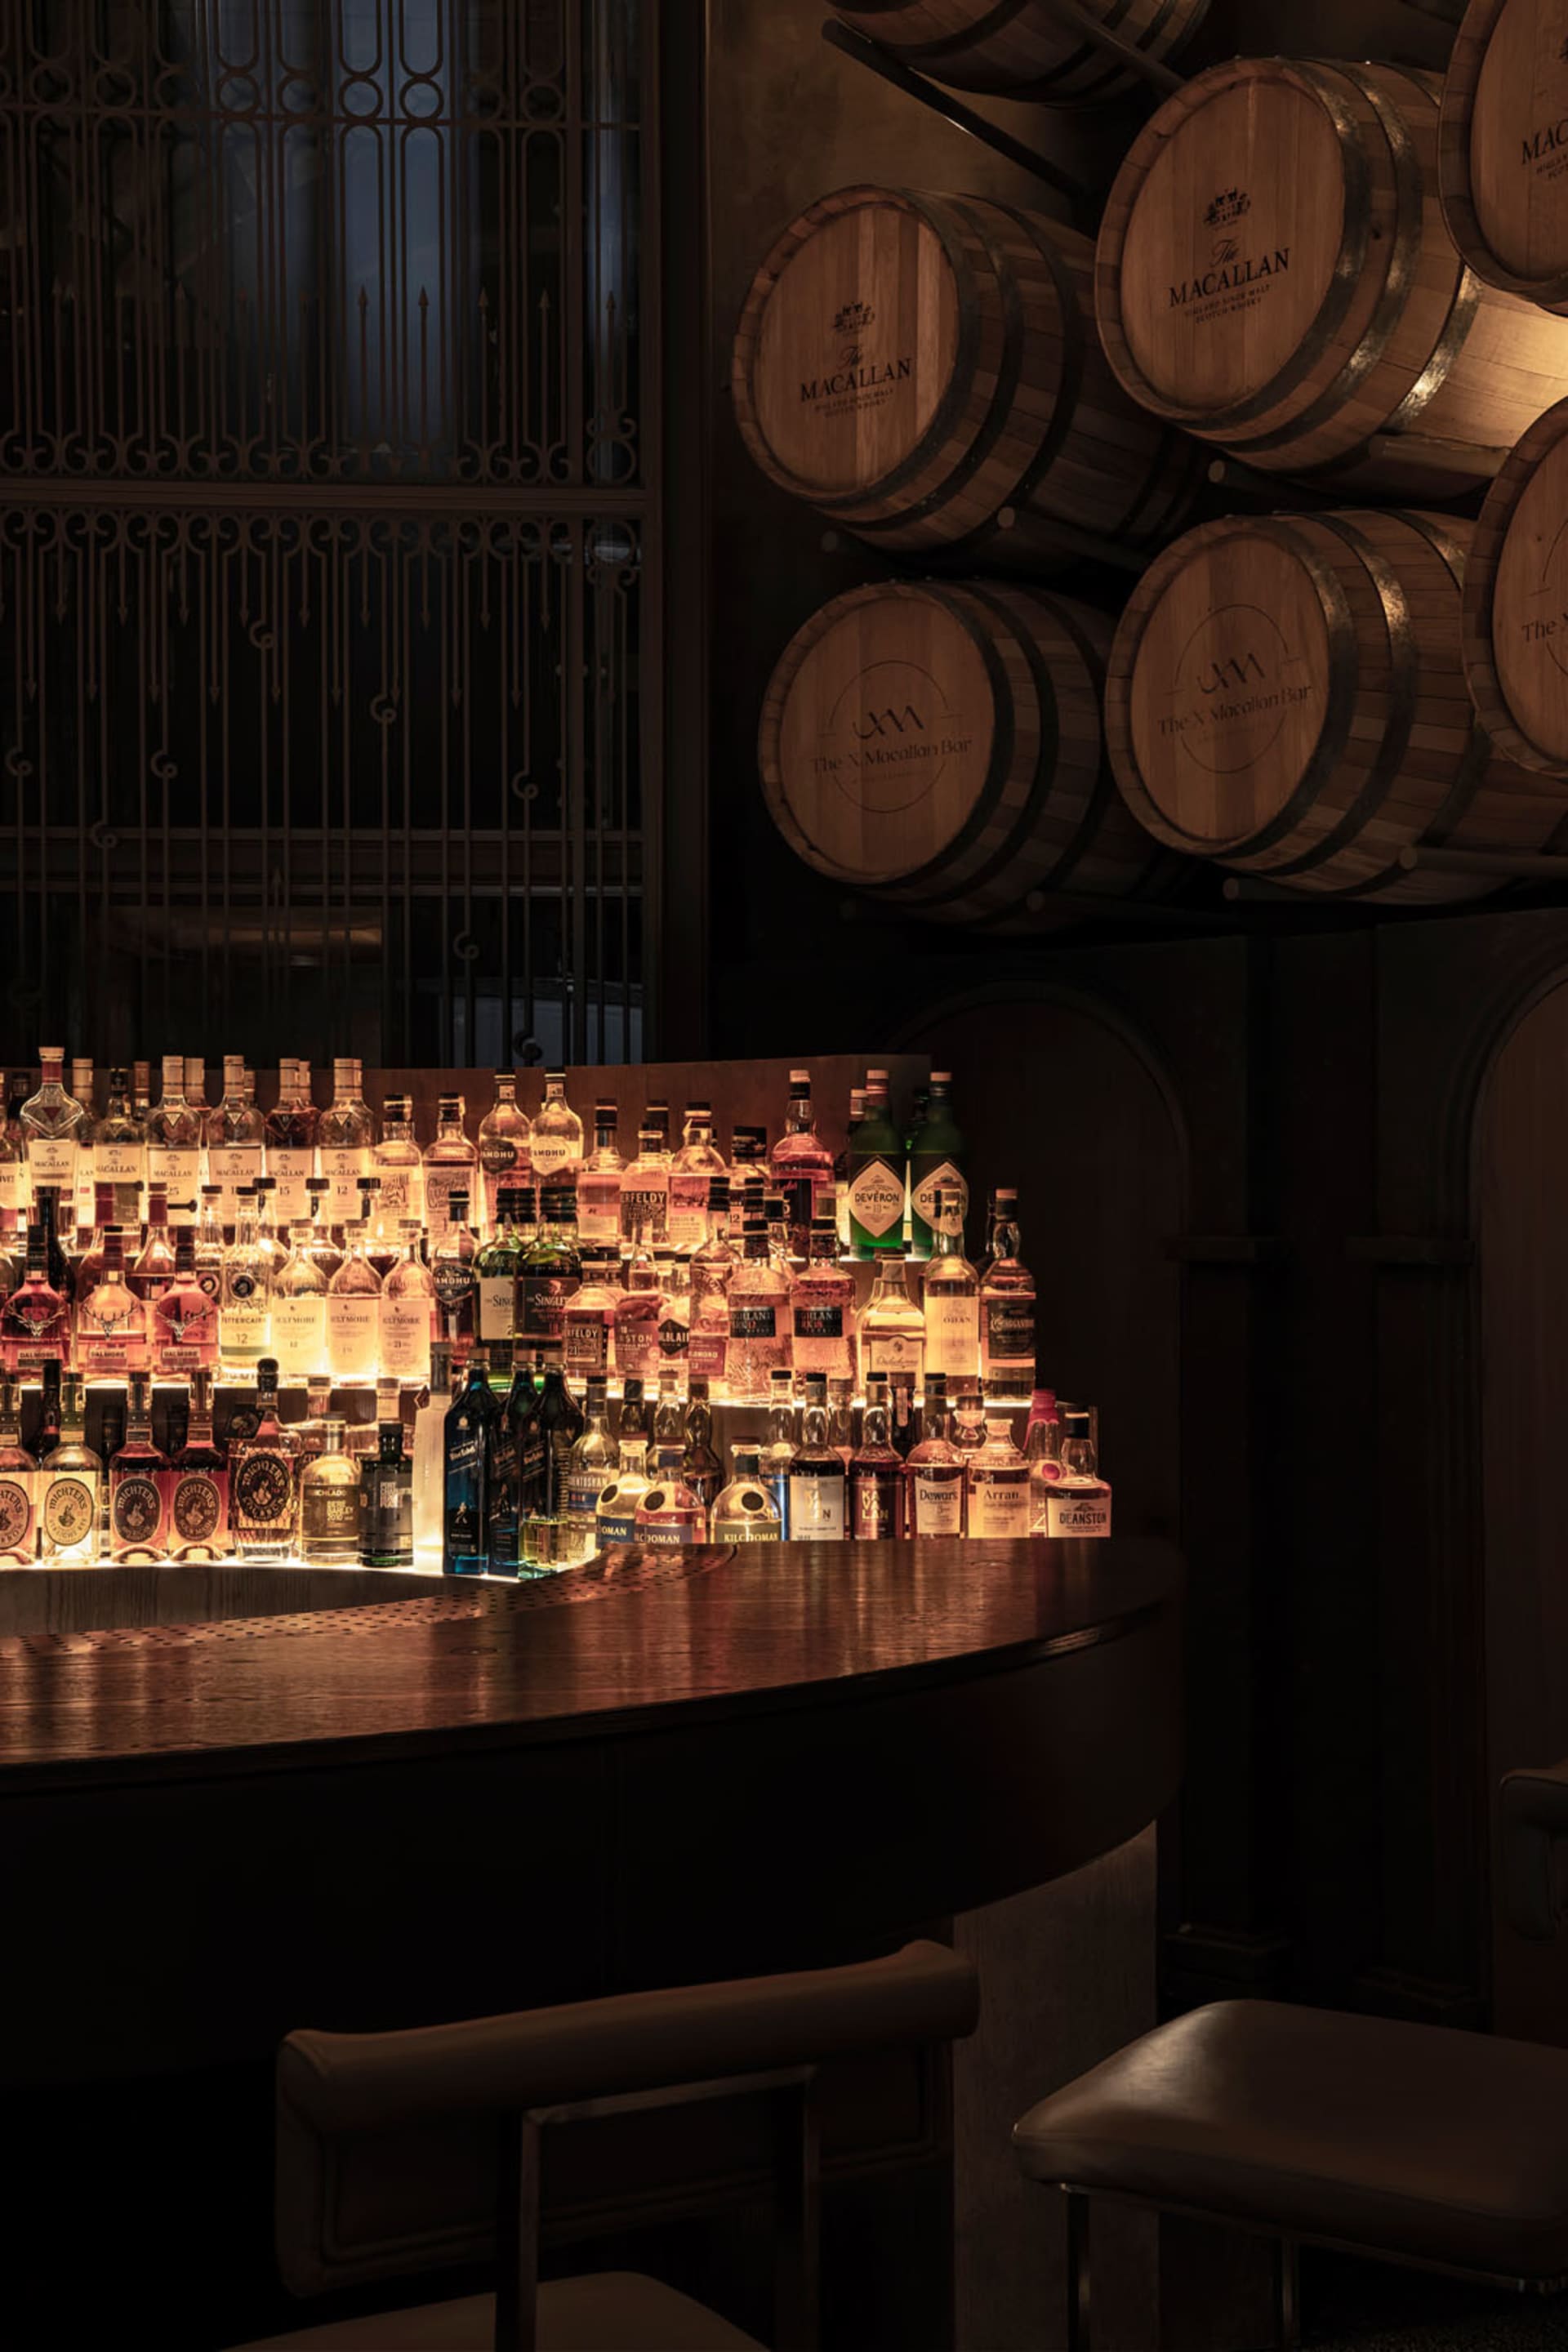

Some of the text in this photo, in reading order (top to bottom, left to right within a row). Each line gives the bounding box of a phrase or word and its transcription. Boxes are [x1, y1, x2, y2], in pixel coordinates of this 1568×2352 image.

[1169, 247, 1290, 308] MACALLAN
[800, 358, 912, 403] MACALLAN
[1521, 619, 1556, 643] The
[1156, 715, 1188, 737] The
[1210, 692, 1279, 722] Macallan
[1281, 684, 1313, 702] Bar
[812, 756, 843, 773] The
[865, 744, 938, 766] Macallan
[941, 738, 973, 756] Bar
[279, 1186, 290, 1196] 15
[336, 1186, 348, 1196] 12
[621, 1192, 665, 1203] ERFELDY
[90, 1350, 125, 1358] DALMORE
[164, 1350, 198, 1358] DALMORE
[983, 1489, 1019, 1499] Arran
[1059, 1512, 1107, 1529] DEANSTON
[724, 1532, 778, 1542] KILCOMAN
